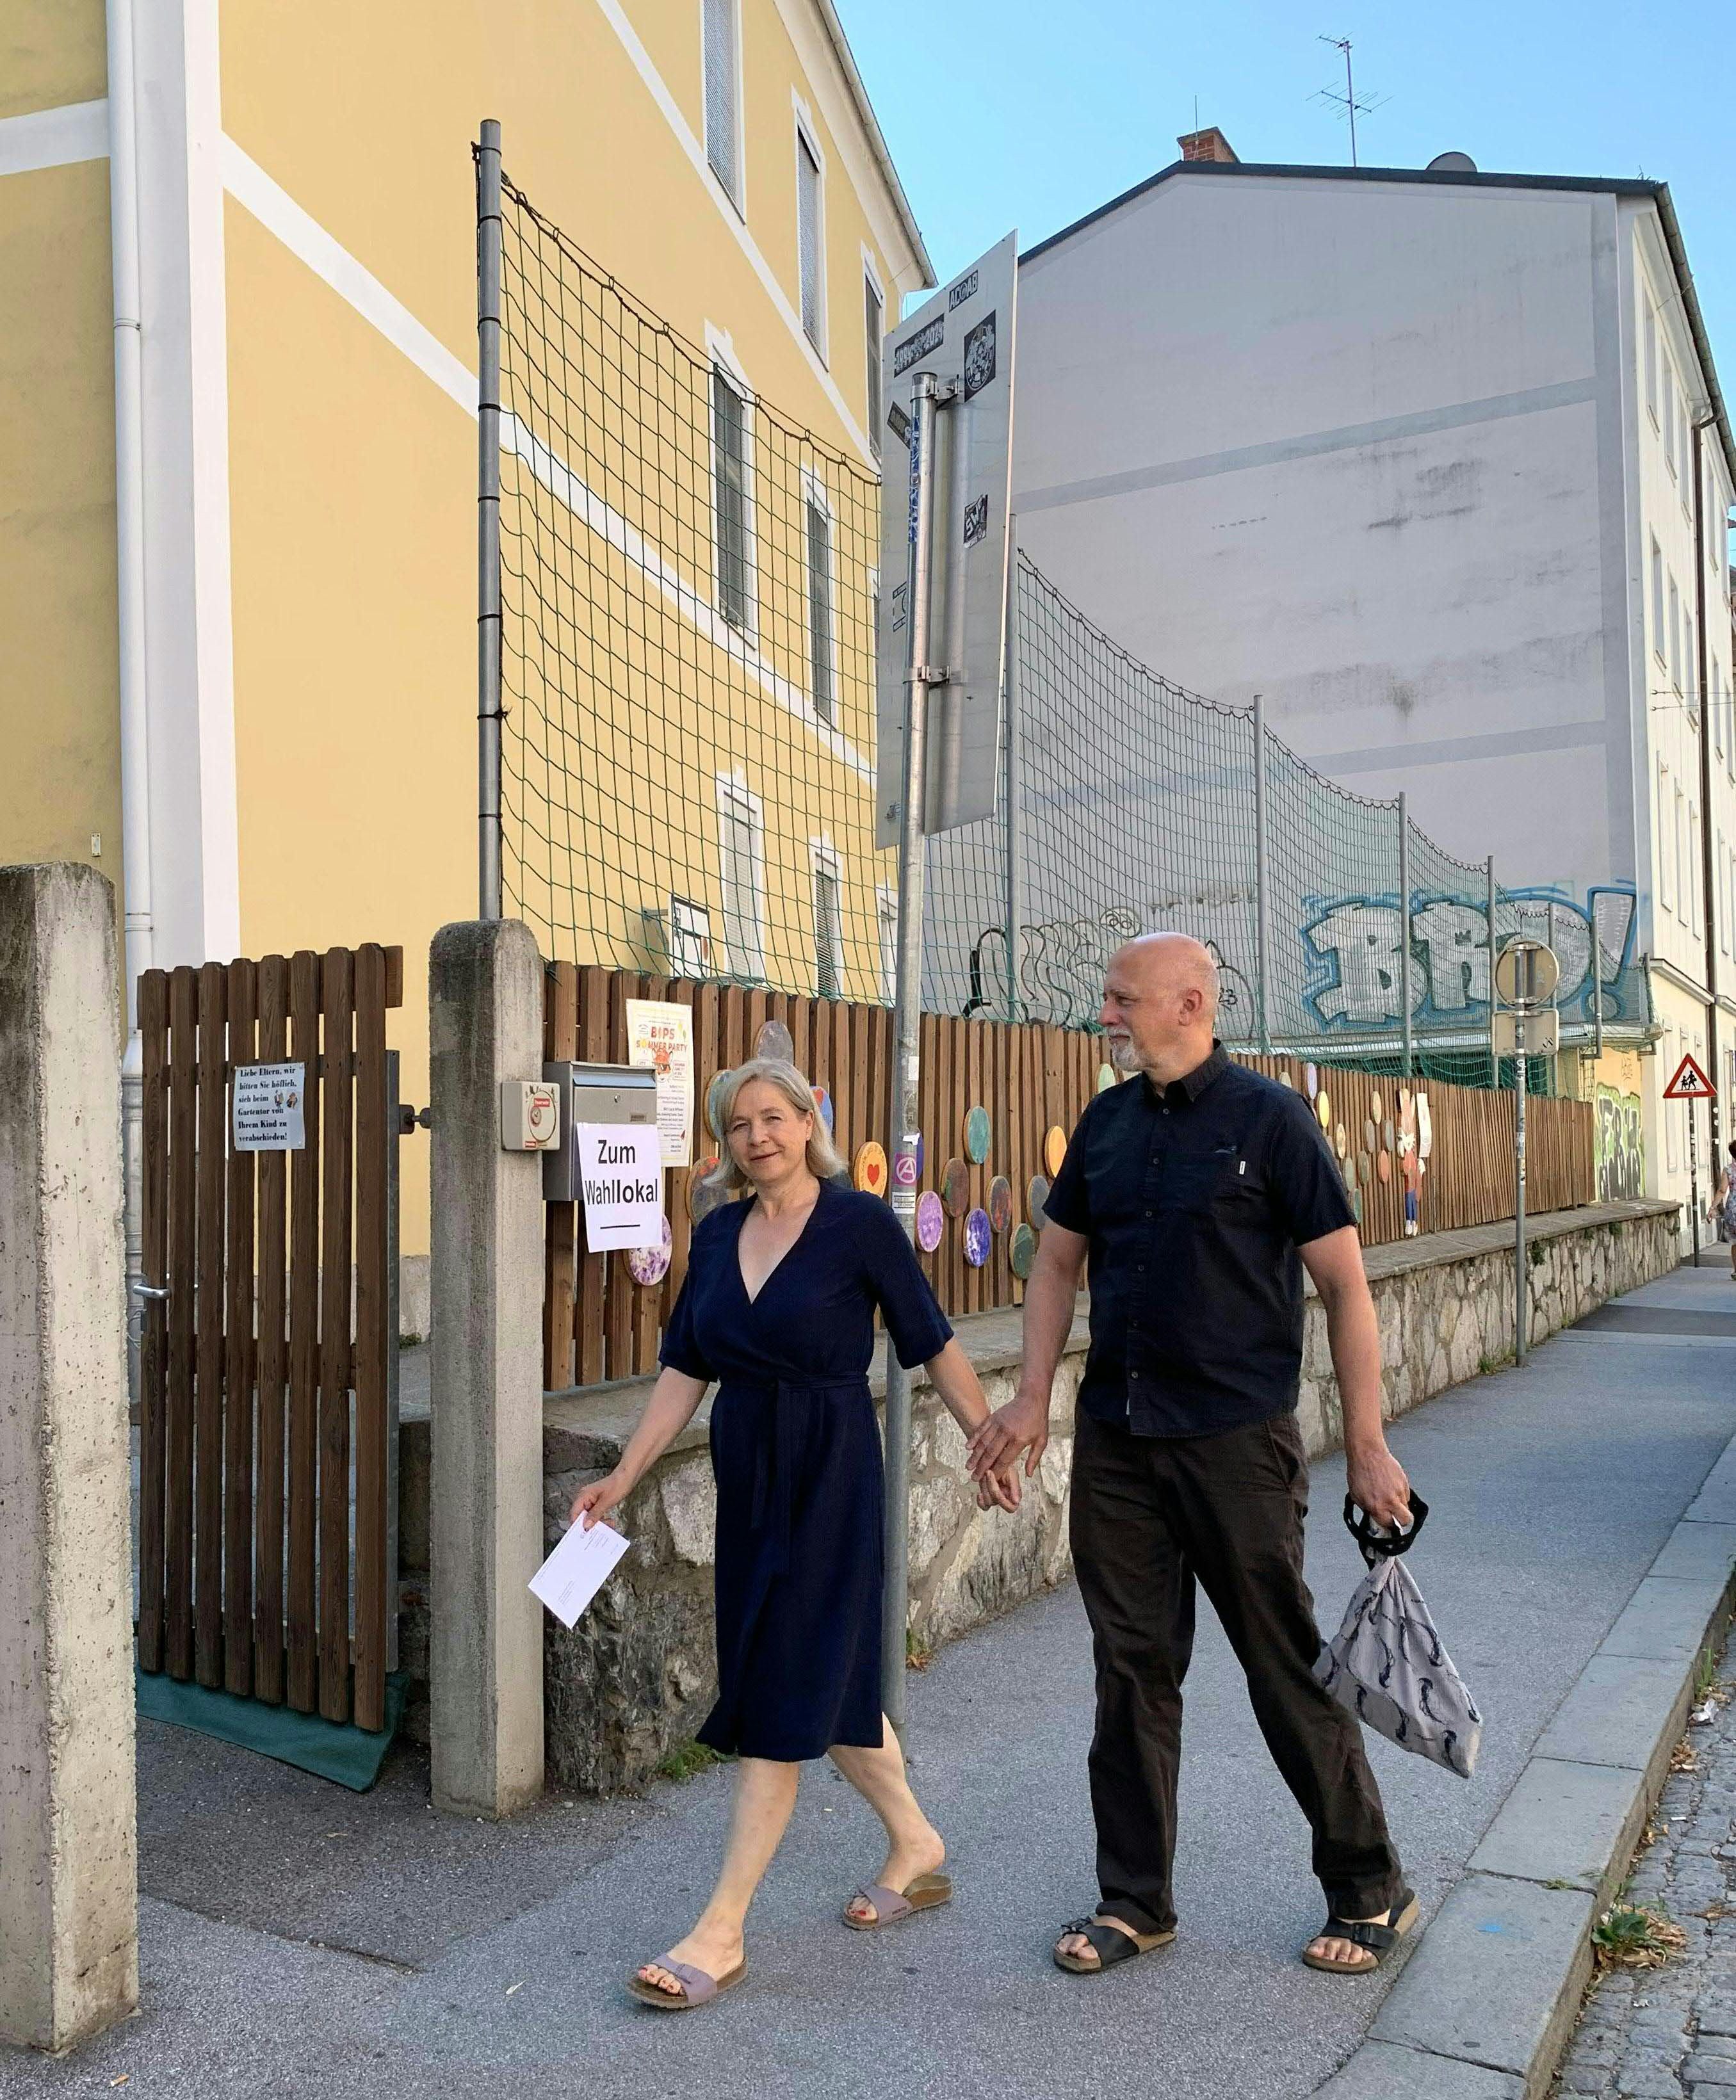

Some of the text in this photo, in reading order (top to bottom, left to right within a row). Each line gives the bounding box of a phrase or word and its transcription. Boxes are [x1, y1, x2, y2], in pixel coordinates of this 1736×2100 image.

[651, 1026, 675, 1040] BIPS
[668, 1042, 688, 1053] PARTY
[239, 1133, 287, 1142] verabschieden!
[598, 1140, 636, 1164] Zum
[585, 1179, 658, 1205] Wahllokal
